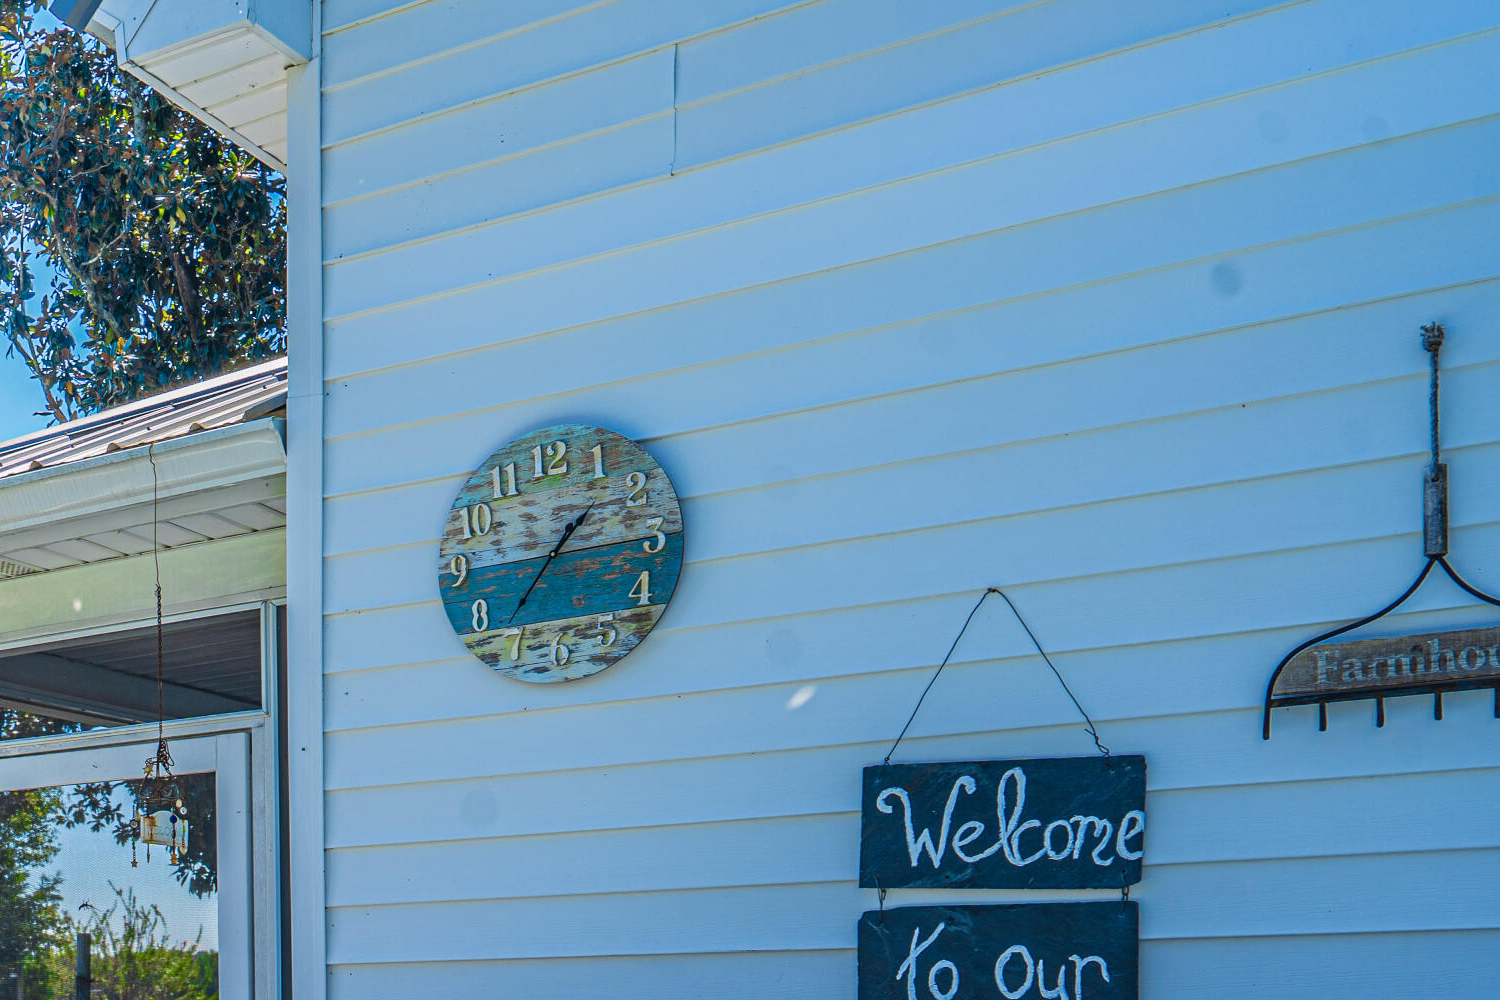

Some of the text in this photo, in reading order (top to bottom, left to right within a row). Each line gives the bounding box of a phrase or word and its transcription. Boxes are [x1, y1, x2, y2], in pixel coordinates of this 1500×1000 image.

[531, 440, 568, 479] 12
[589, 444, 607, 479] 1
[489, 462, 520, 499] 11
[625, 471, 648, 507] 2
[459, 503, 493, 540] 10
[642, 516, 666, 553] 3
[449, 554, 469, 588] 9
[628, 571, 653, 606] 4
[470, 599, 490, 633] 8
[596, 613, 617, 647] 5
[504, 625, 524, 661] 7
[551, 632, 570, 666] 6
[876, 766, 1145, 868] Welcome
